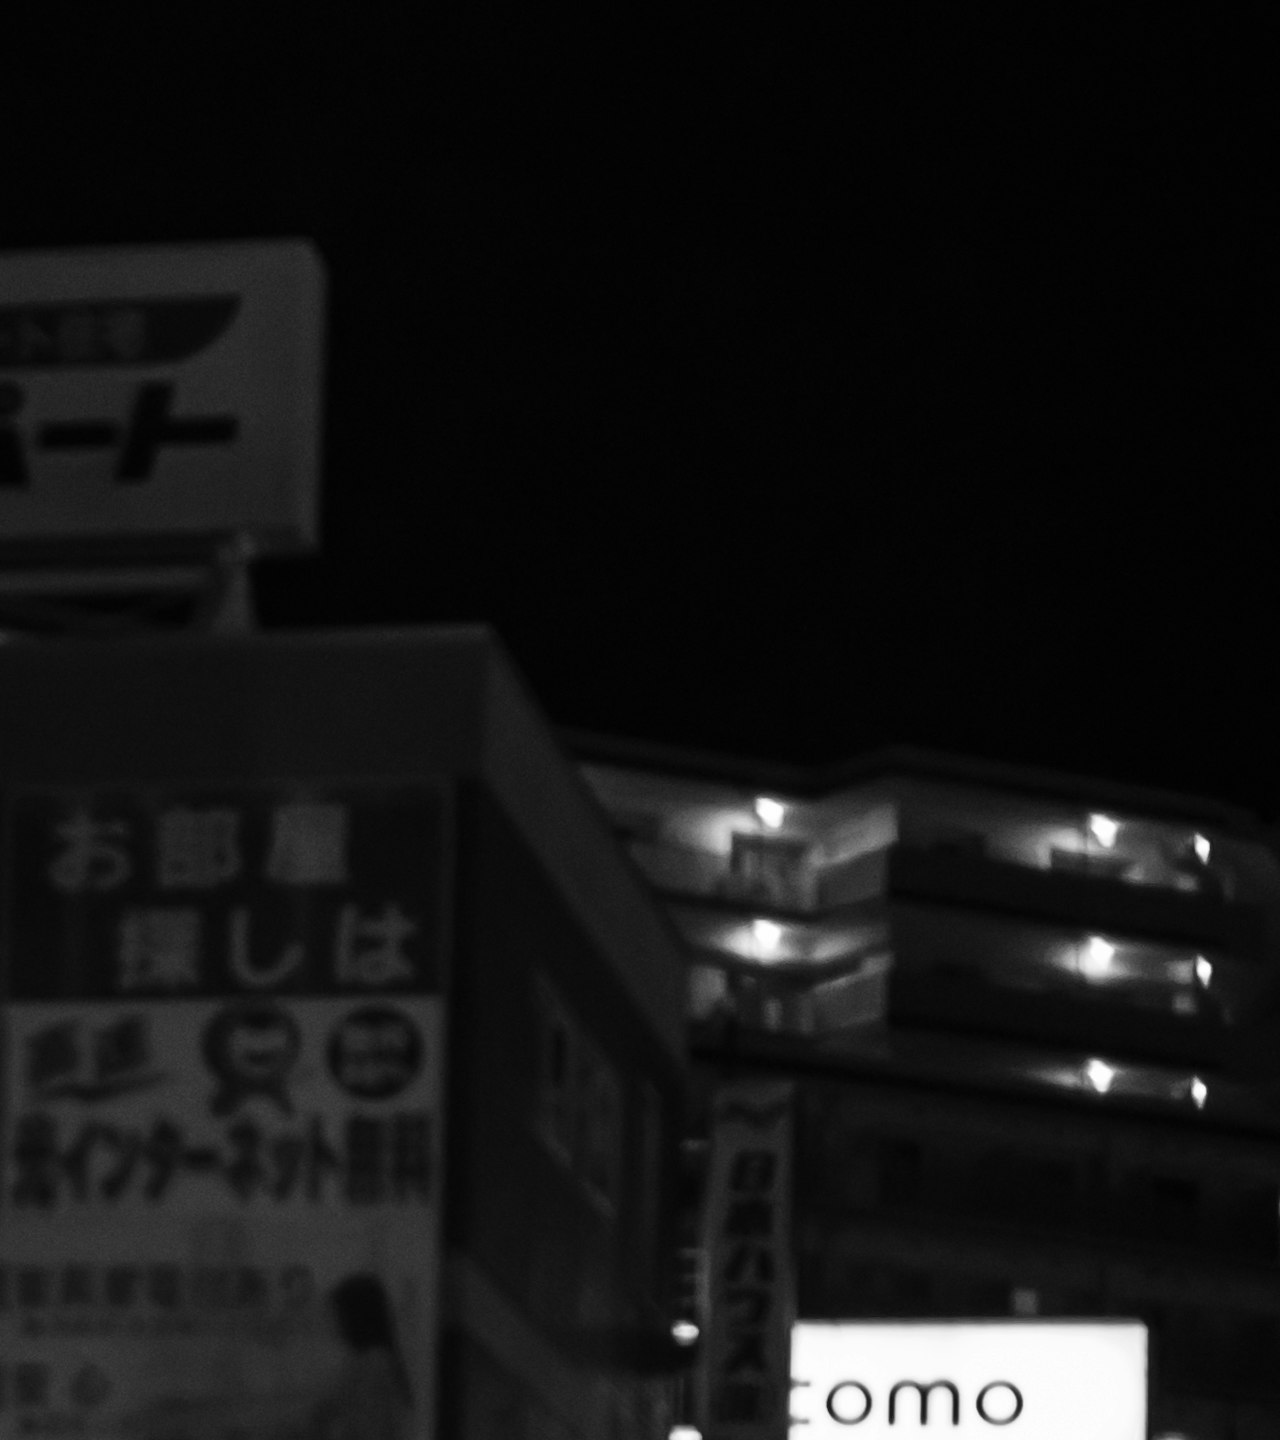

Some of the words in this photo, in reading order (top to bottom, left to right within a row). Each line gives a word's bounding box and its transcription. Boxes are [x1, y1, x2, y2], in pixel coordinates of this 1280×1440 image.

[48, 803, 348, 893] お部屋
[120, 904, 417, 990] 探しは
